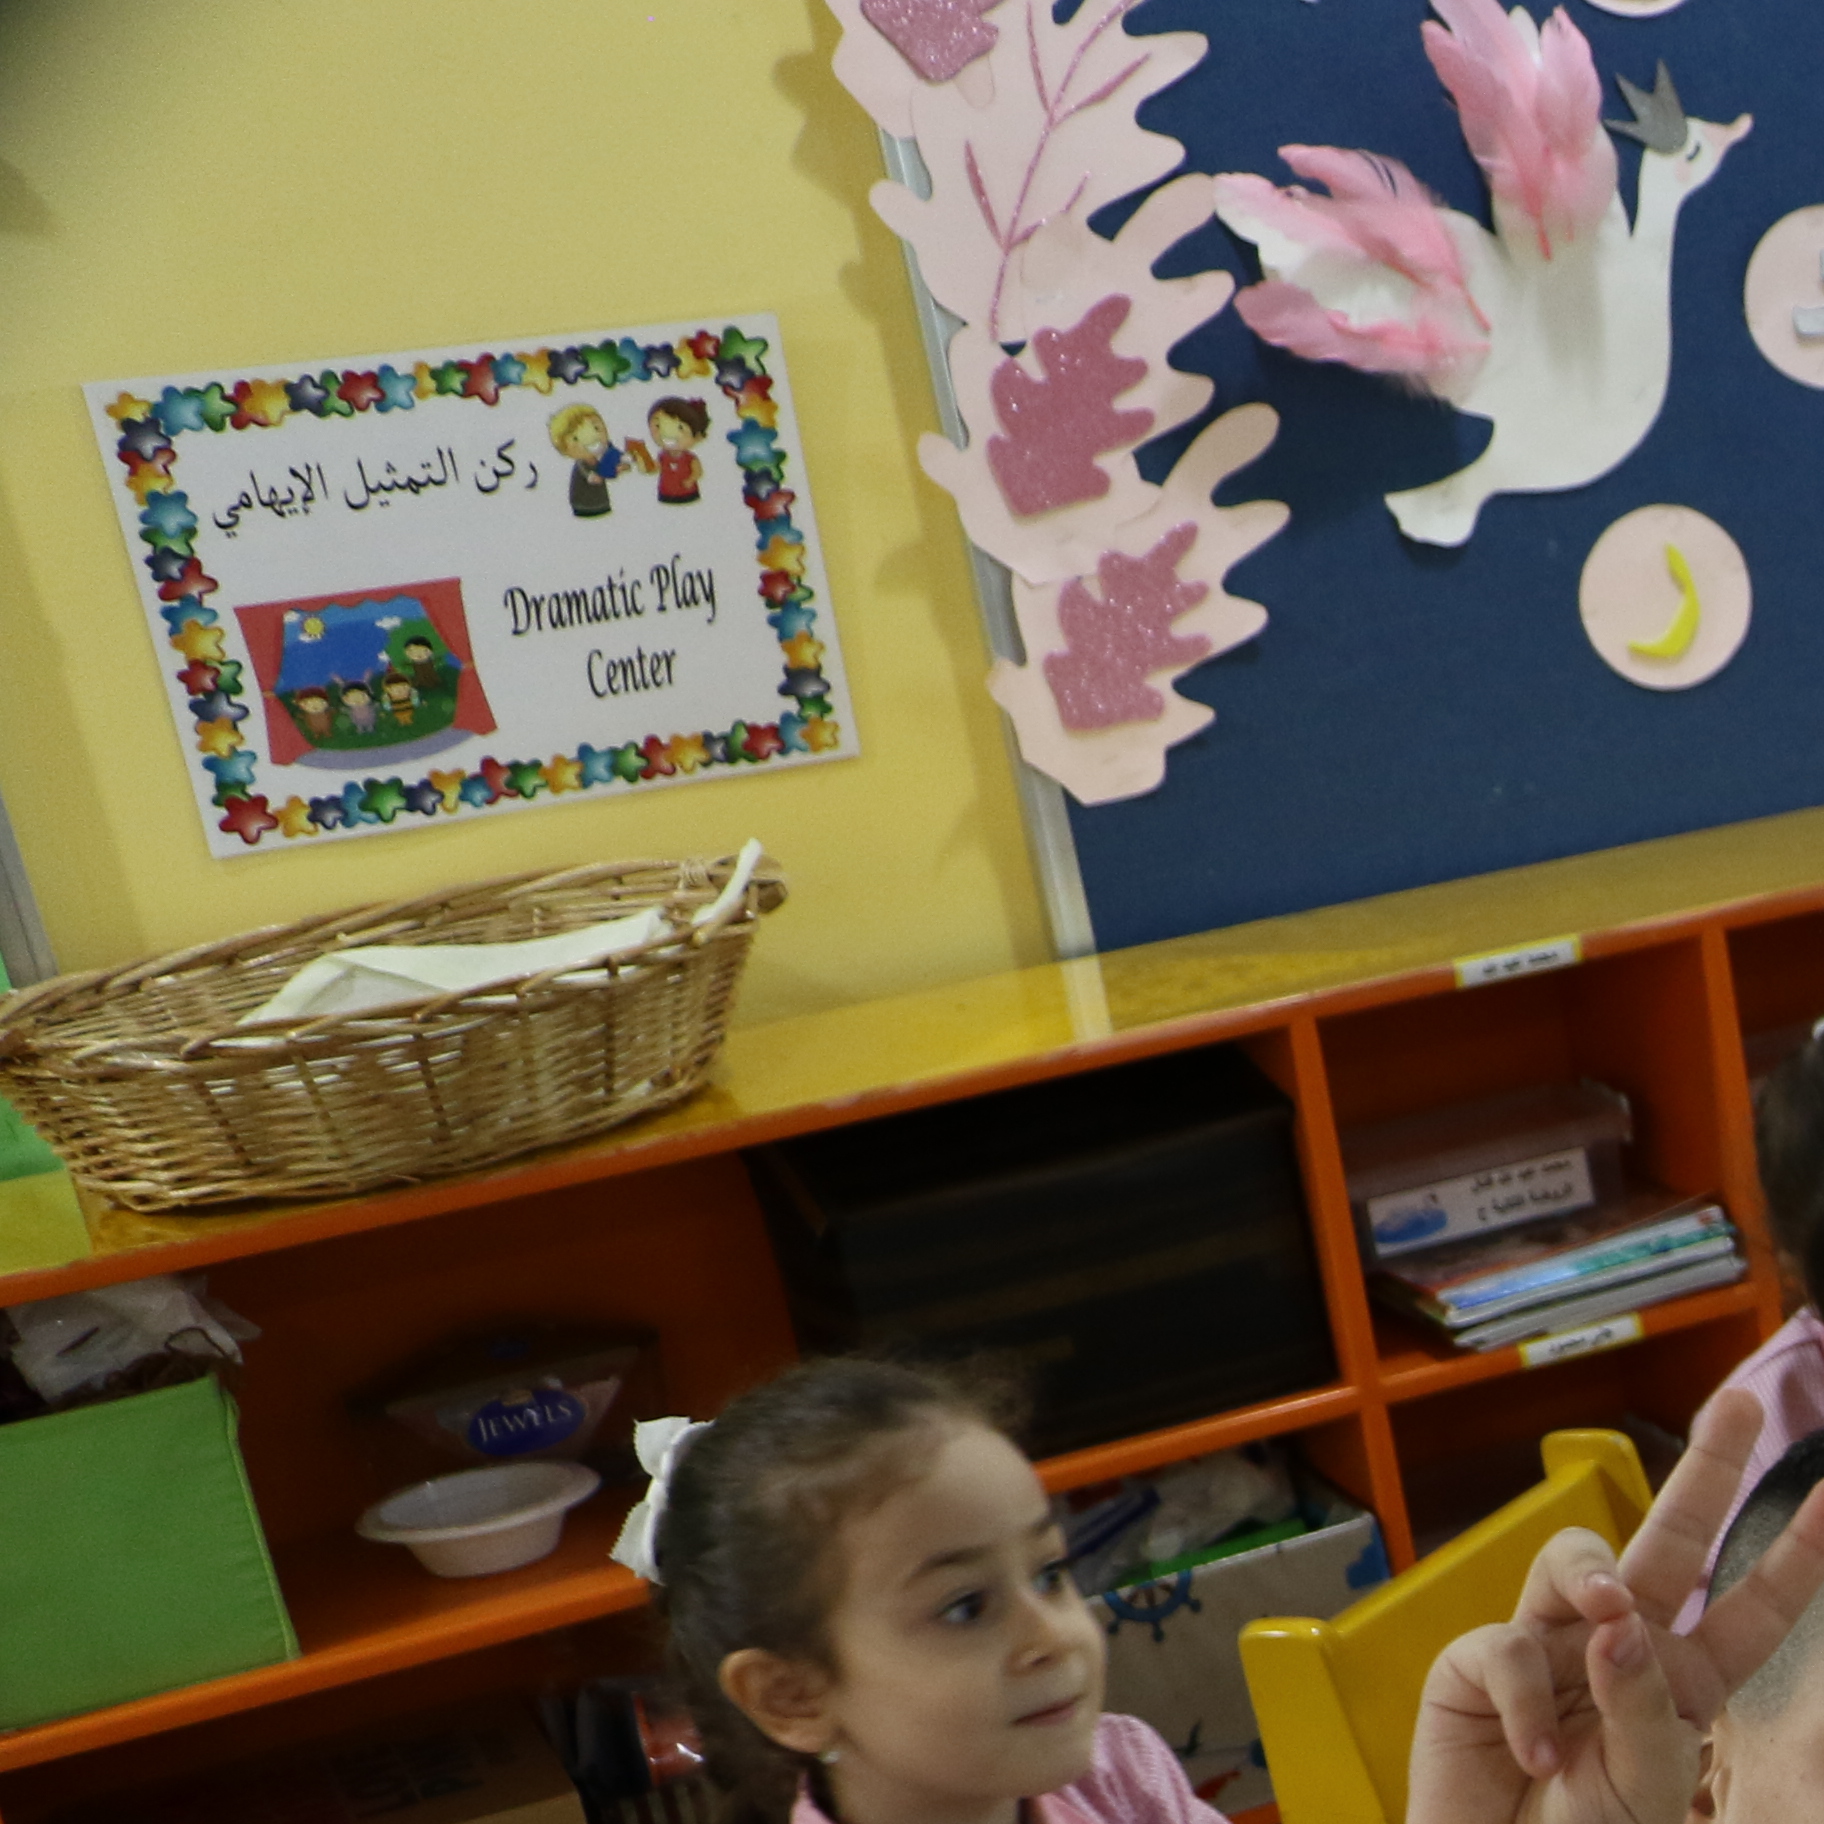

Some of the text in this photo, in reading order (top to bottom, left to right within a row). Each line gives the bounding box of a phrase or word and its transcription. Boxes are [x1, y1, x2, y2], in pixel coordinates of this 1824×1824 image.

[213, 438, 539, 538] ركن التمثيل الإيهامي
[504, 553, 719, 637] Dramatic Play
[586, 644, 677, 700] Center
